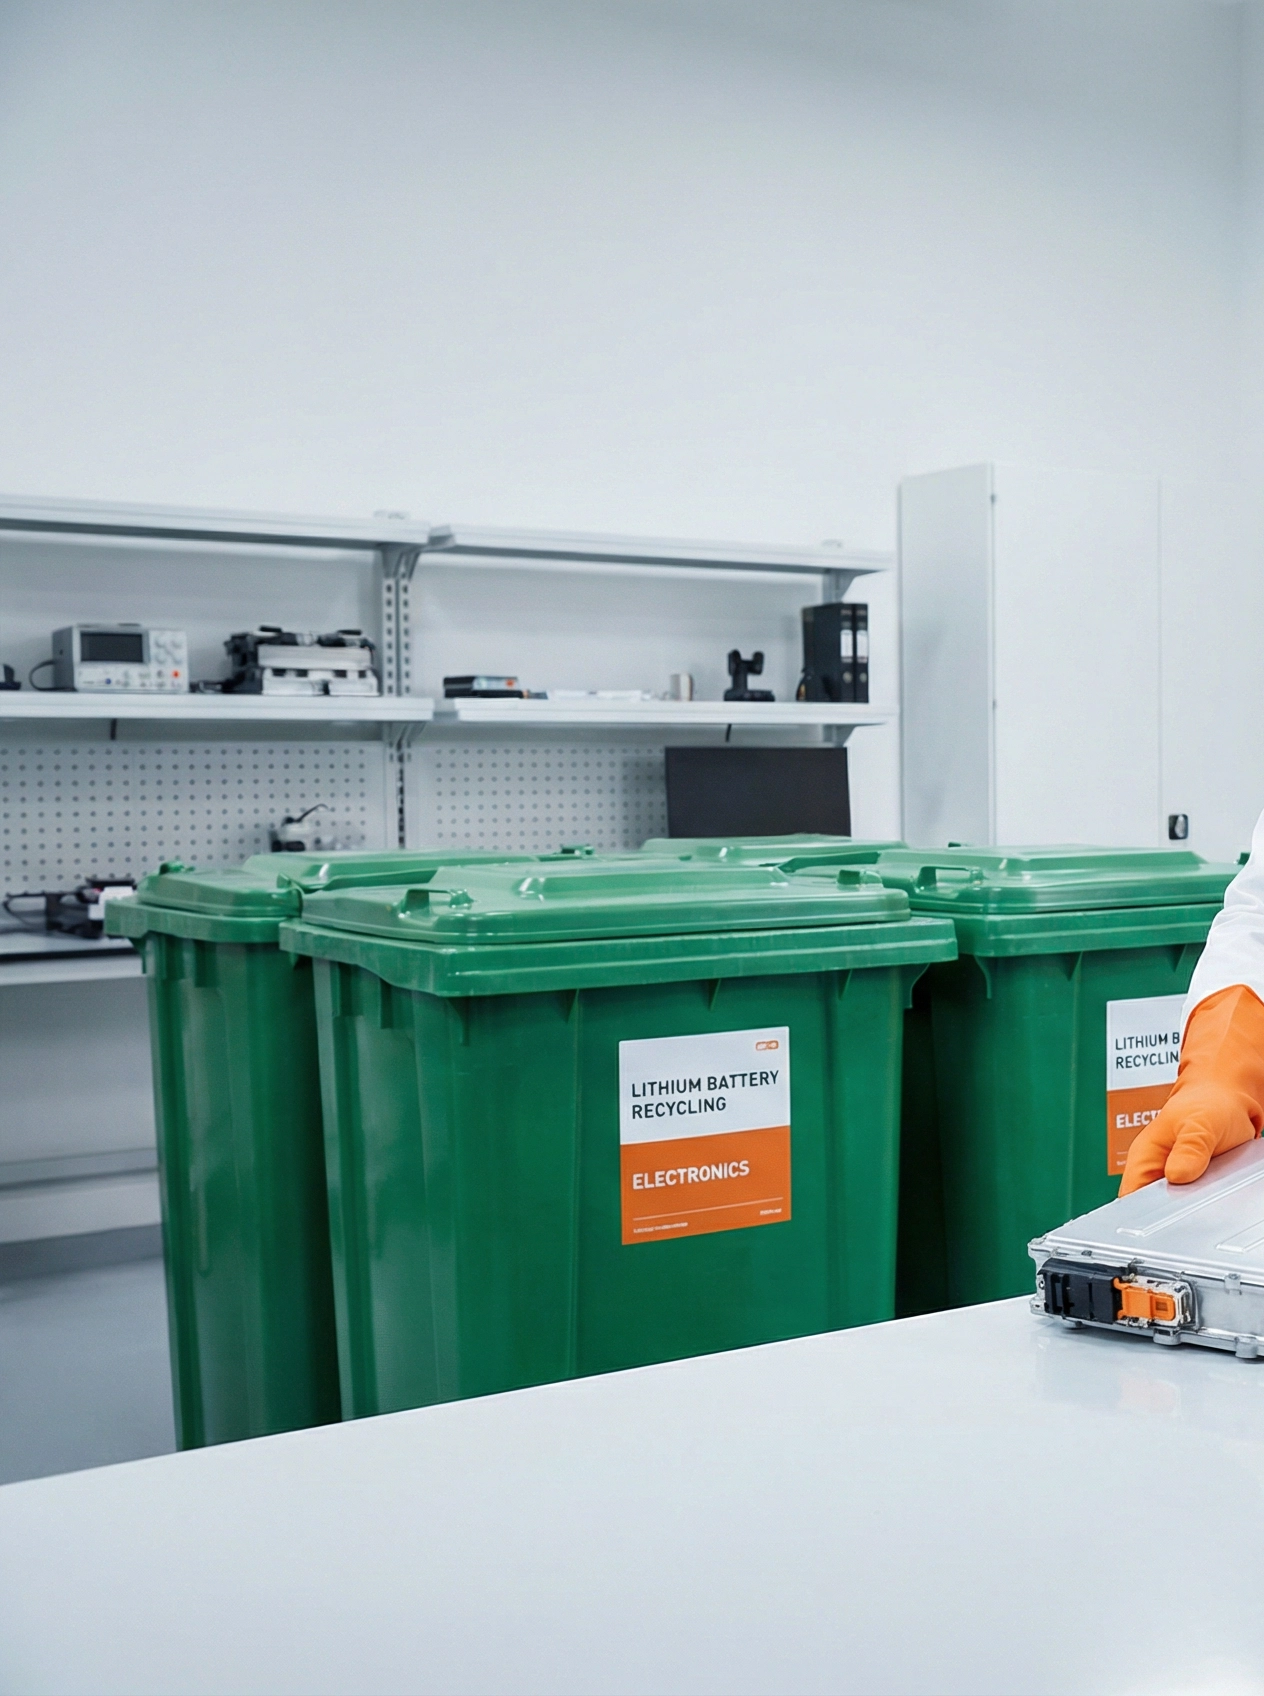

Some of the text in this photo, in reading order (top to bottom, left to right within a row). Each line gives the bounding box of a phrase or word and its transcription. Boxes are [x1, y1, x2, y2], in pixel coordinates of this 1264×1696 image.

[1116, 1034, 1167, 1050] LITHIUM
[1116, 1052, 1178, 1069] RECYCLIN
[632, 1070, 779, 1098] LITHIUM BATTERY
[632, 1097, 726, 1119] RECYCLING
[632, 1160, 750, 1190] ELECTRONICS
